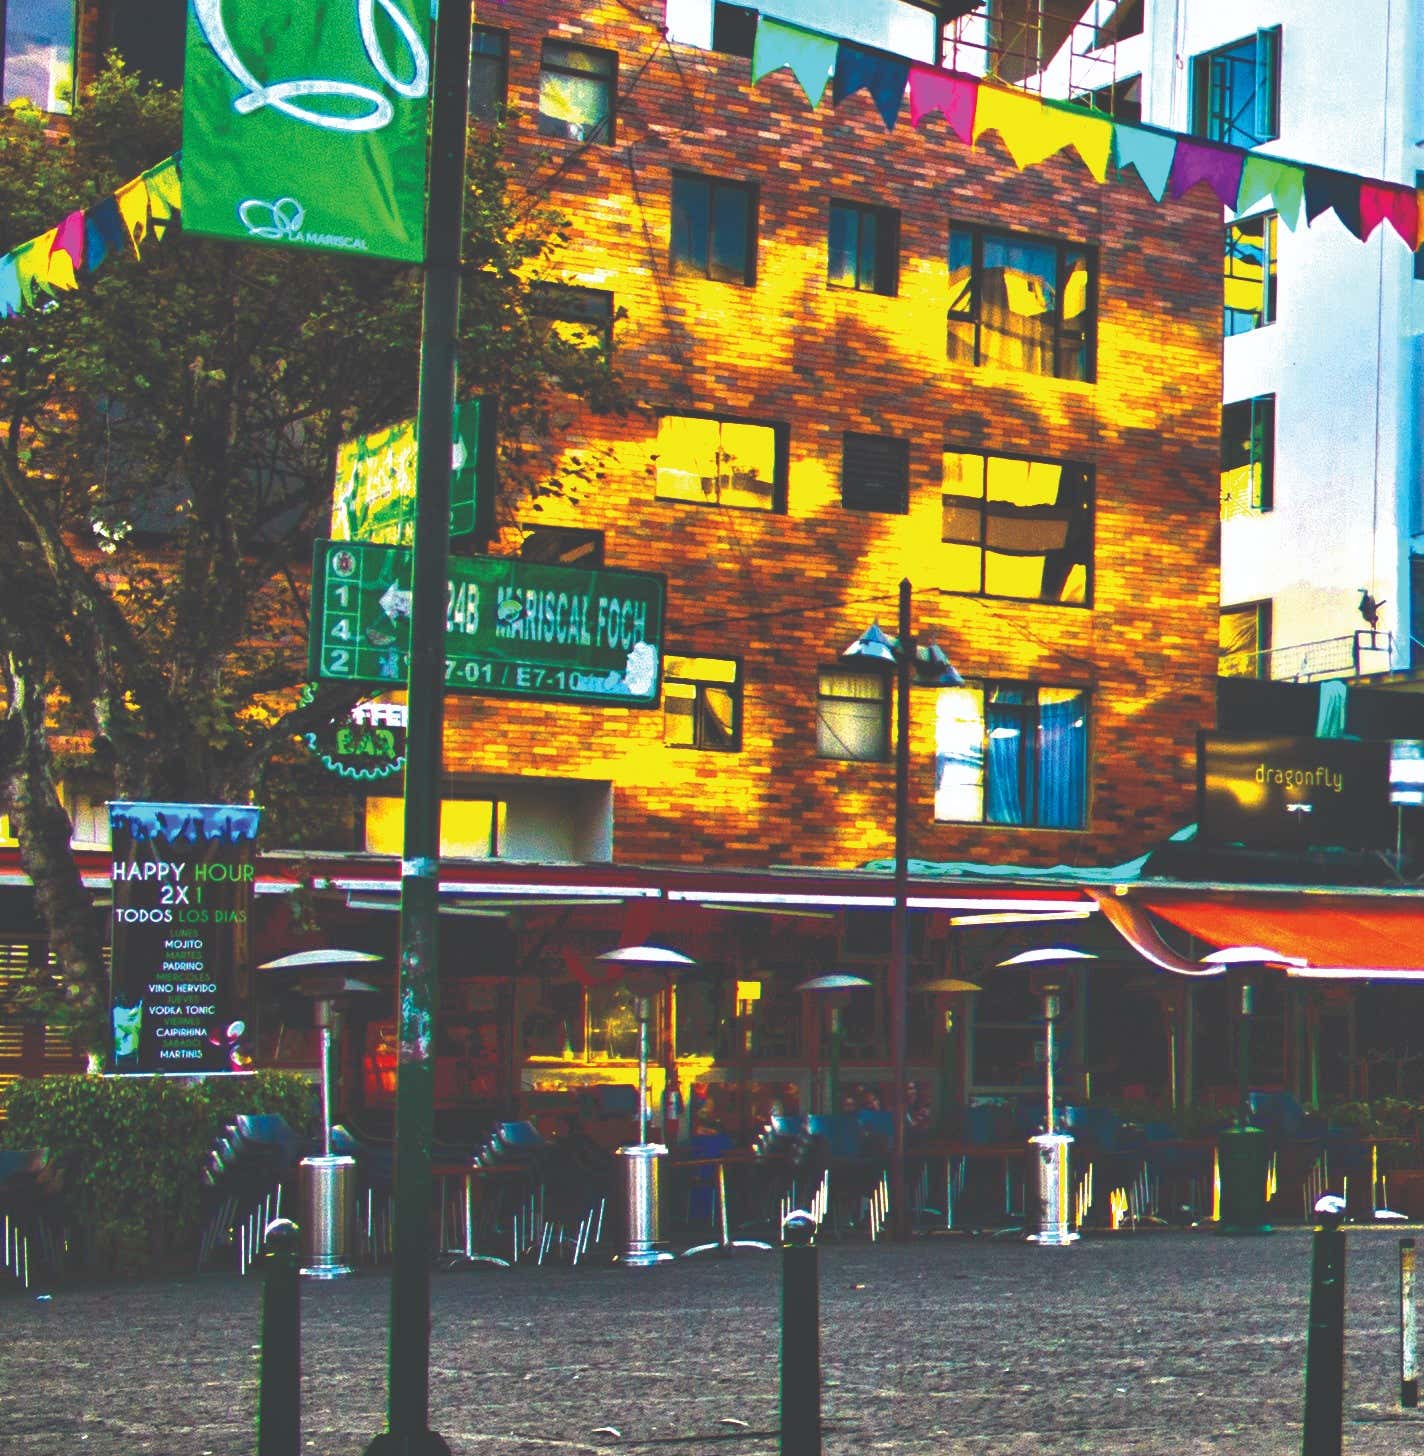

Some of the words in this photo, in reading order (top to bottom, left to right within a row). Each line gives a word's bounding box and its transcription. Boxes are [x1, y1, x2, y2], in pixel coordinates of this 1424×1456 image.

[288, 231, 304, 242] LA
[306, 233, 368, 250] MARISCAL
[496, 586, 591, 646] MARISCAL
[597, 596, 646, 650] FOCH
[1255, 763, 1342, 792] dragonfly
[113, 862, 185, 881] HAPPY
[195, 863, 255, 882] HOUR
[161, 885, 189, 904] 2X
[116, 909, 173, 922] TODOS
[178, 910, 209, 922] LOS
[215, 910, 247, 923] DIAS
[165, 940, 203, 949] MOJITO
[163, 962, 204, 971] PADRINO
[148, 984, 174, 992] VINO
[176, 984, 217, 992] HERVIDO
[149, 1006, 182, 1015] VODKA
[185, 1006, 216, 1015] TONIC
[160, 1049, 203, 1059] MARTINIS
